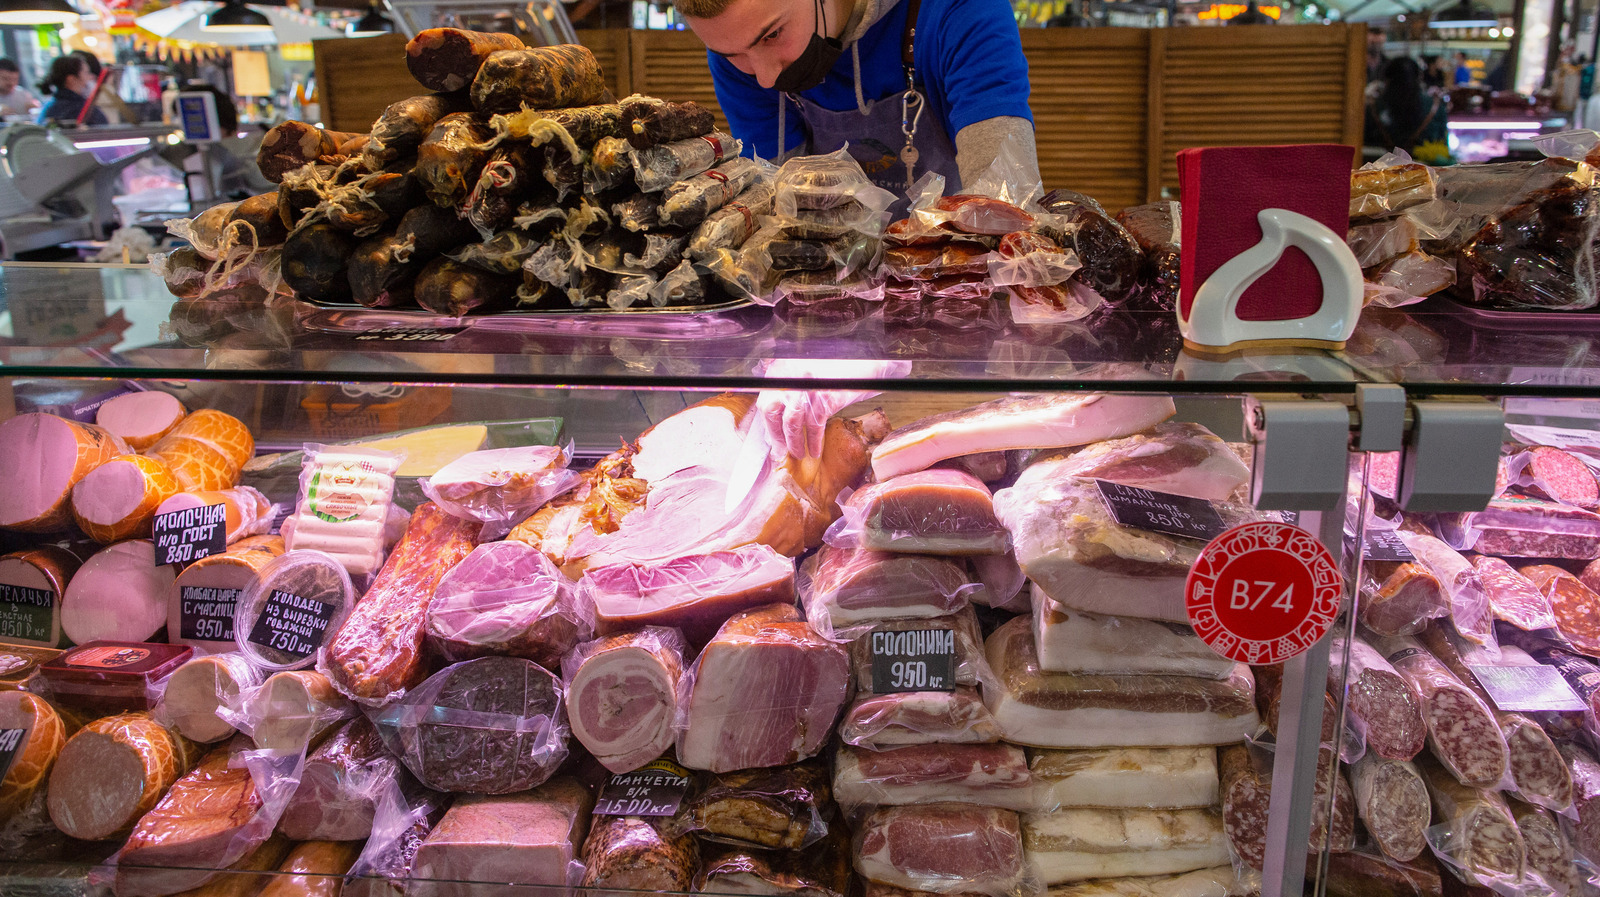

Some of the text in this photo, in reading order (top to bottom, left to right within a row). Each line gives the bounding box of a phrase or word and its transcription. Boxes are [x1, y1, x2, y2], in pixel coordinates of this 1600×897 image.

[1114, 484, 1155, 500] САЛО
[155, 503, 226, 531] МОЛОЧНАЯ
[1146, 511, 1184, 529] 850
[181, 523, 218, 544] ГОСТ
[166, 543, 193, 564] 850
[273, 591, 323, 615] ХОЛОДЕЦ
[1230, 579, 1294, 613] B74
[266, 603, 328, 631] ИЗ ВЫРЕЗКИ
[2, 620, 22, 637] 950
[196, 619, 223, 638] 950
[269, 630, 299, 652] 750
[872, 629, 954, 656] СОЛОНИНА
[891, 661, 927, 688] 950
[0, 729, 23, 751] АЯ
[611, 776, 689, 787] ПАНЧЕТТА
